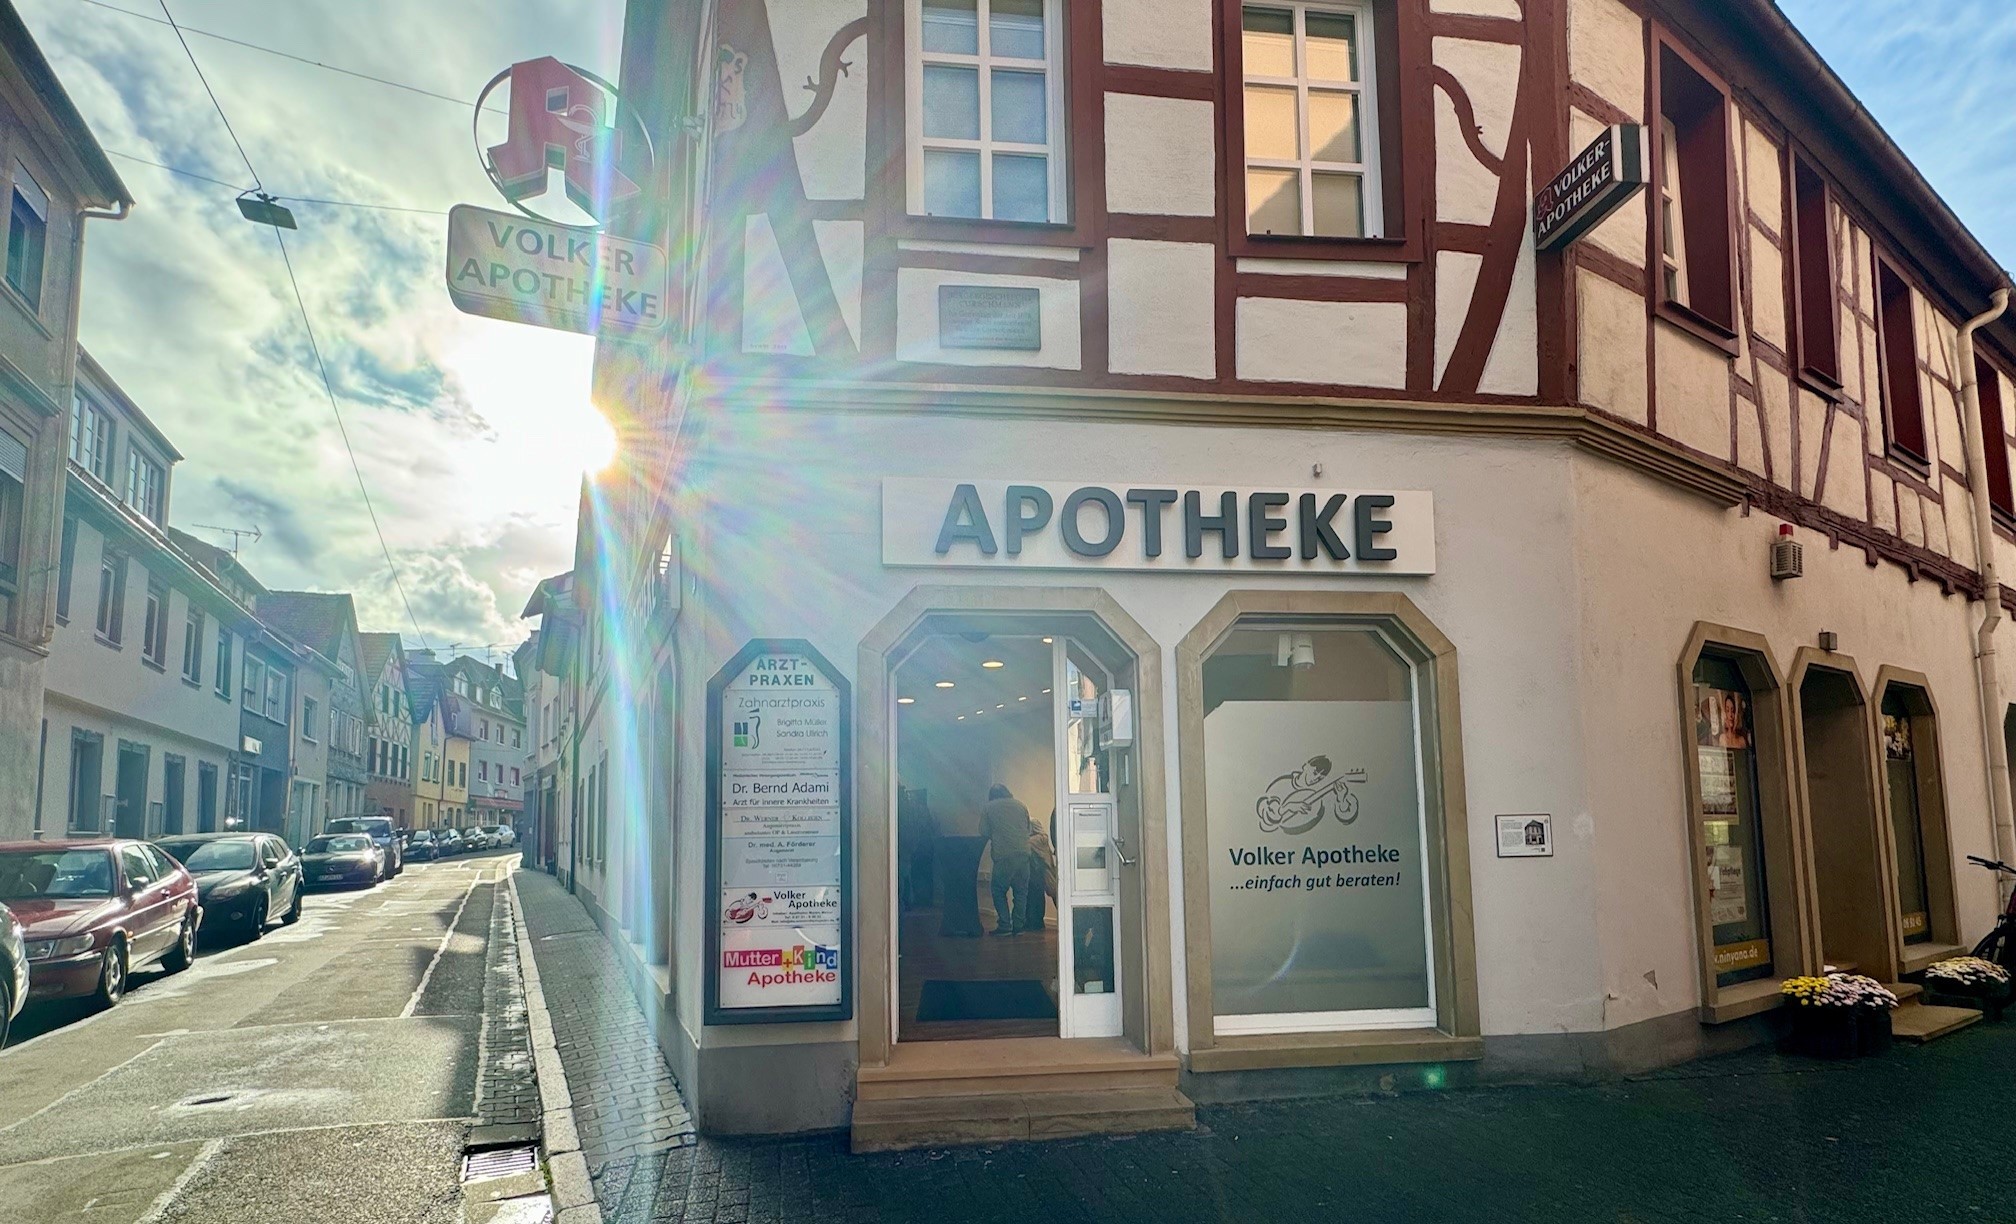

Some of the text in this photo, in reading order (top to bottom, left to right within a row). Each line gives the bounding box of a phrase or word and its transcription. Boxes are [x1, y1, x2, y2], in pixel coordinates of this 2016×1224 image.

[1537, 160, 1611, 239] APOTHEKE
[487, 220, 636, 276] VOLKER
[456, 256, 658, 320] APOTHEKE
[934, 483, 1398, 562] APOTHEKE
[756, 658, 808, 671] ARZT-
[749, 674, 815, 687] PRAXEN
[738, 697, 826, 709] Zahnarztpraxis
[776, 730, 804, 738] Sandra
[732, 781, 830, 794] Dr. Bernd Adami
[749, 798, 760, 806] für
[786, 798, 830, 806] Krankheiten
[1228, 844, 1400, 868] Volker Apotheke
[1230, 872, 1401, 892] ...einfach gut beraten!
[773, 890, 806, 900] Volker
[788, 899, 838, 910] Apotheke
[747, 970, 836, 988] Apotheke
